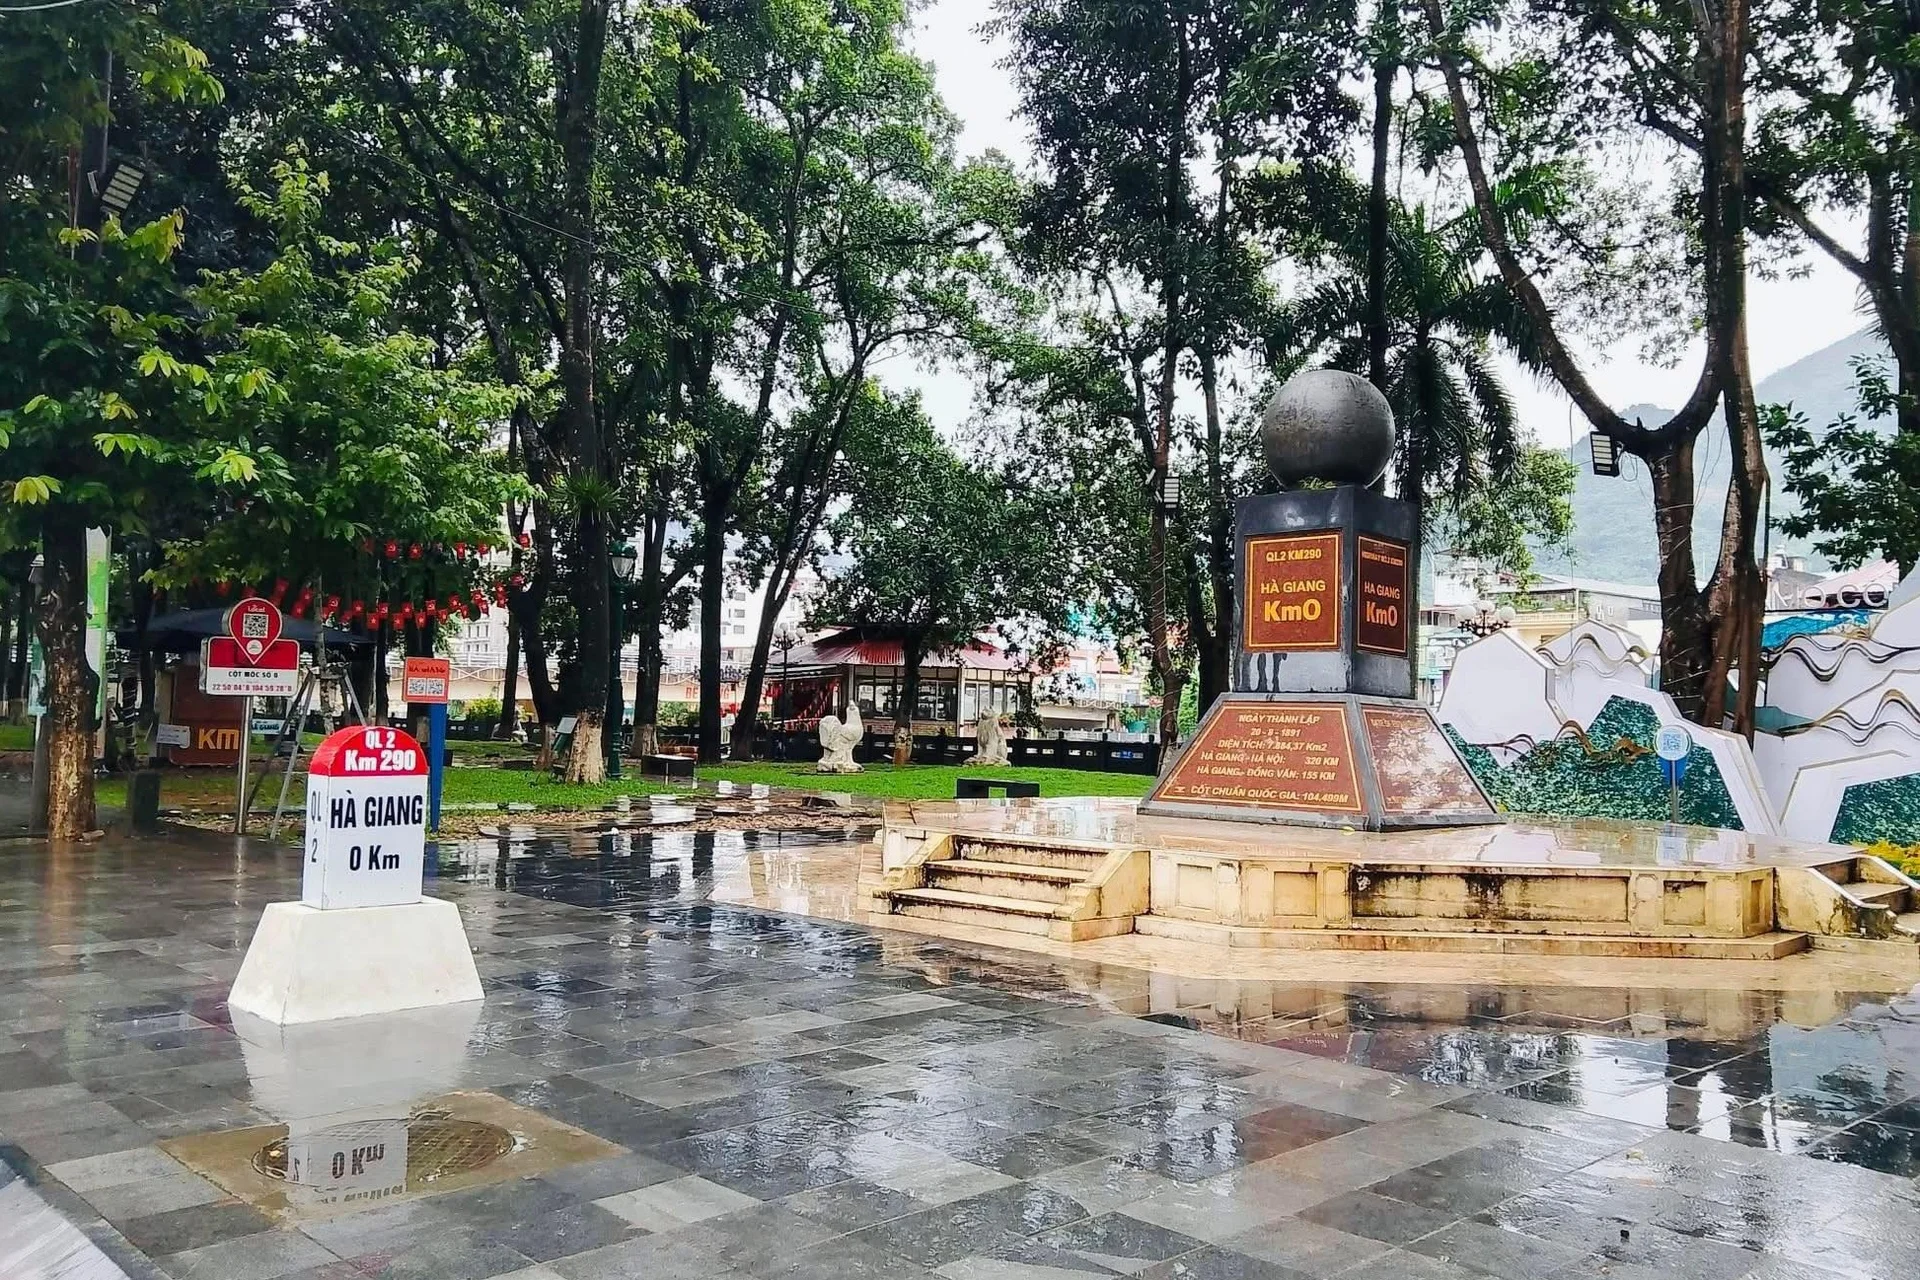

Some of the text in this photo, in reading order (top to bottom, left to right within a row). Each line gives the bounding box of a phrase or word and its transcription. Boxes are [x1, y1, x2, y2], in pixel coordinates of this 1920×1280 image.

[1266, 549, 1321, 562] QL2 KM290
[1260, 579, 1326, 594] HÀ GIANG
[1376, 584, 1400, 600] GIANG
[365, 730, 395, 749] QL 2
[1250, 728, 1261, 736] 20
[1267, 728, 1274, 736] 8
[1281, 729, 1301, 737] 1891
[344, 749, 417, 771] Km 290
[1215, 752, 1245, 762] GIANG
[1304, 756, 1321, 765] 320
[1323, 757, 1339, 766] KM
[1301, 771, 1318, 780] 155
[1319, 771, 1336, 780] KM
[311, 790, 322, 825] QL
[330, 789, 423, 829] HÀ GIANG
[311, 838, 318, 863] 2
[349, 845, 400, 871] 0 Km
